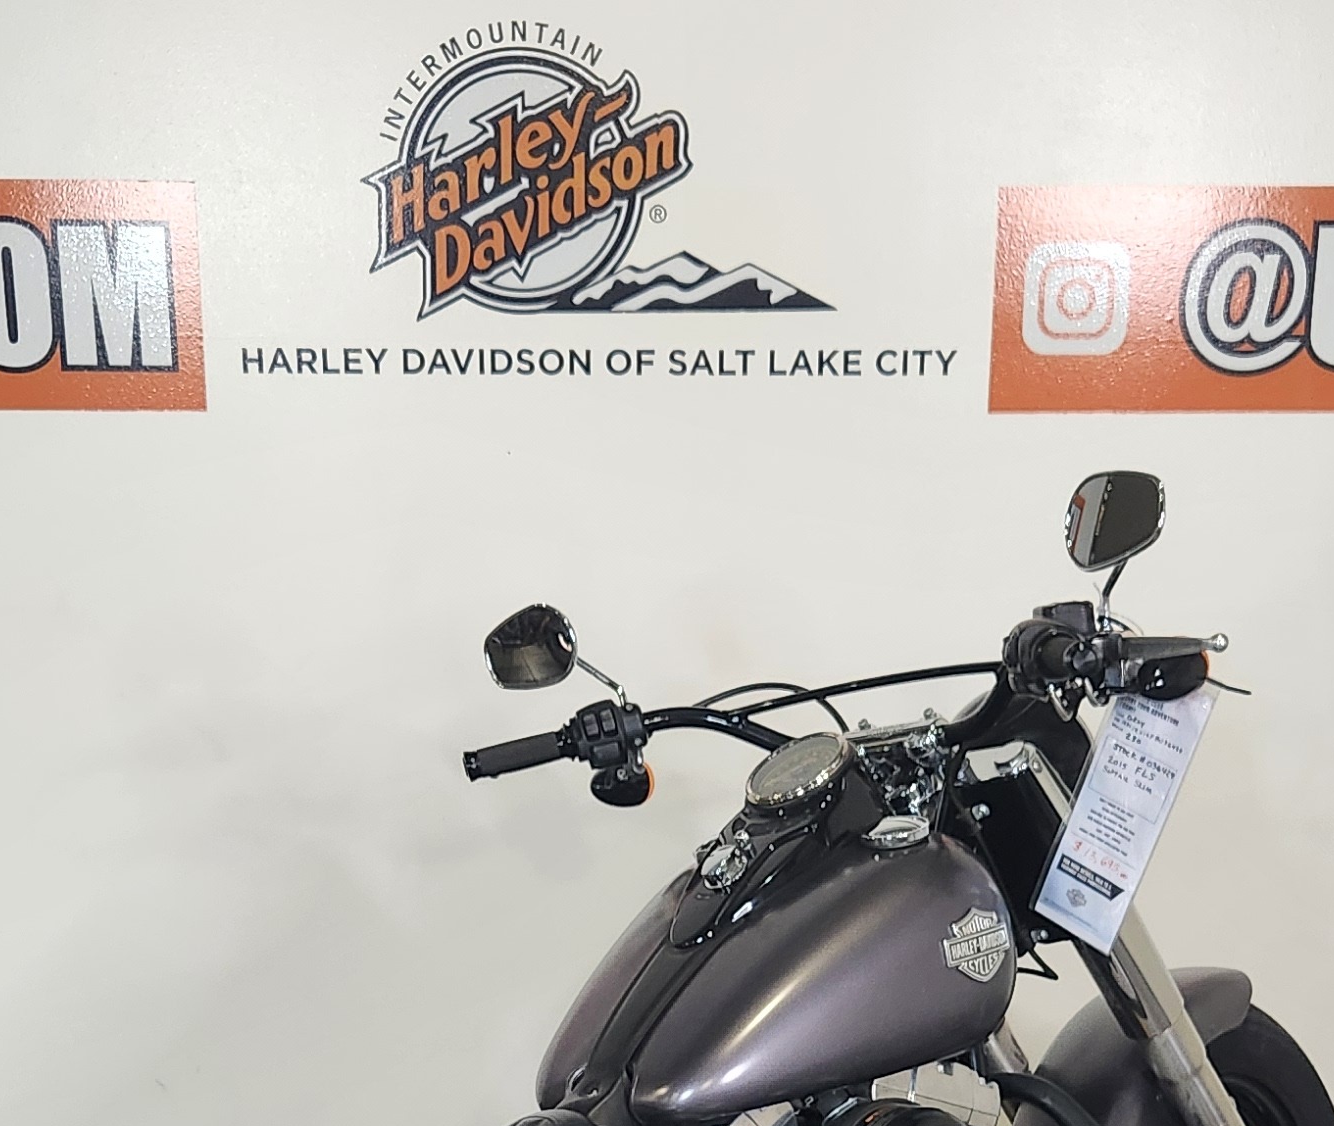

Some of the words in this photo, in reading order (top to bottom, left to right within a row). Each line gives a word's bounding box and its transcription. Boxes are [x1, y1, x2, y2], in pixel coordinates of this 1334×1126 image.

[380, 20, 603, 141] INTERMOUNTAIN
[435, 124, 675, 295] Davidson
[242, 347, 388, 375] HARLEY
[402, 348, 591, 376] DAVIDSON
[606, 349, 655, 376] OF
[668, 349, 755, 377] SALT
[769, 349, 862, 377] LAKE
[875, 349, 957, 377] CITY
[968, 953, 999, 976] CYCLES
